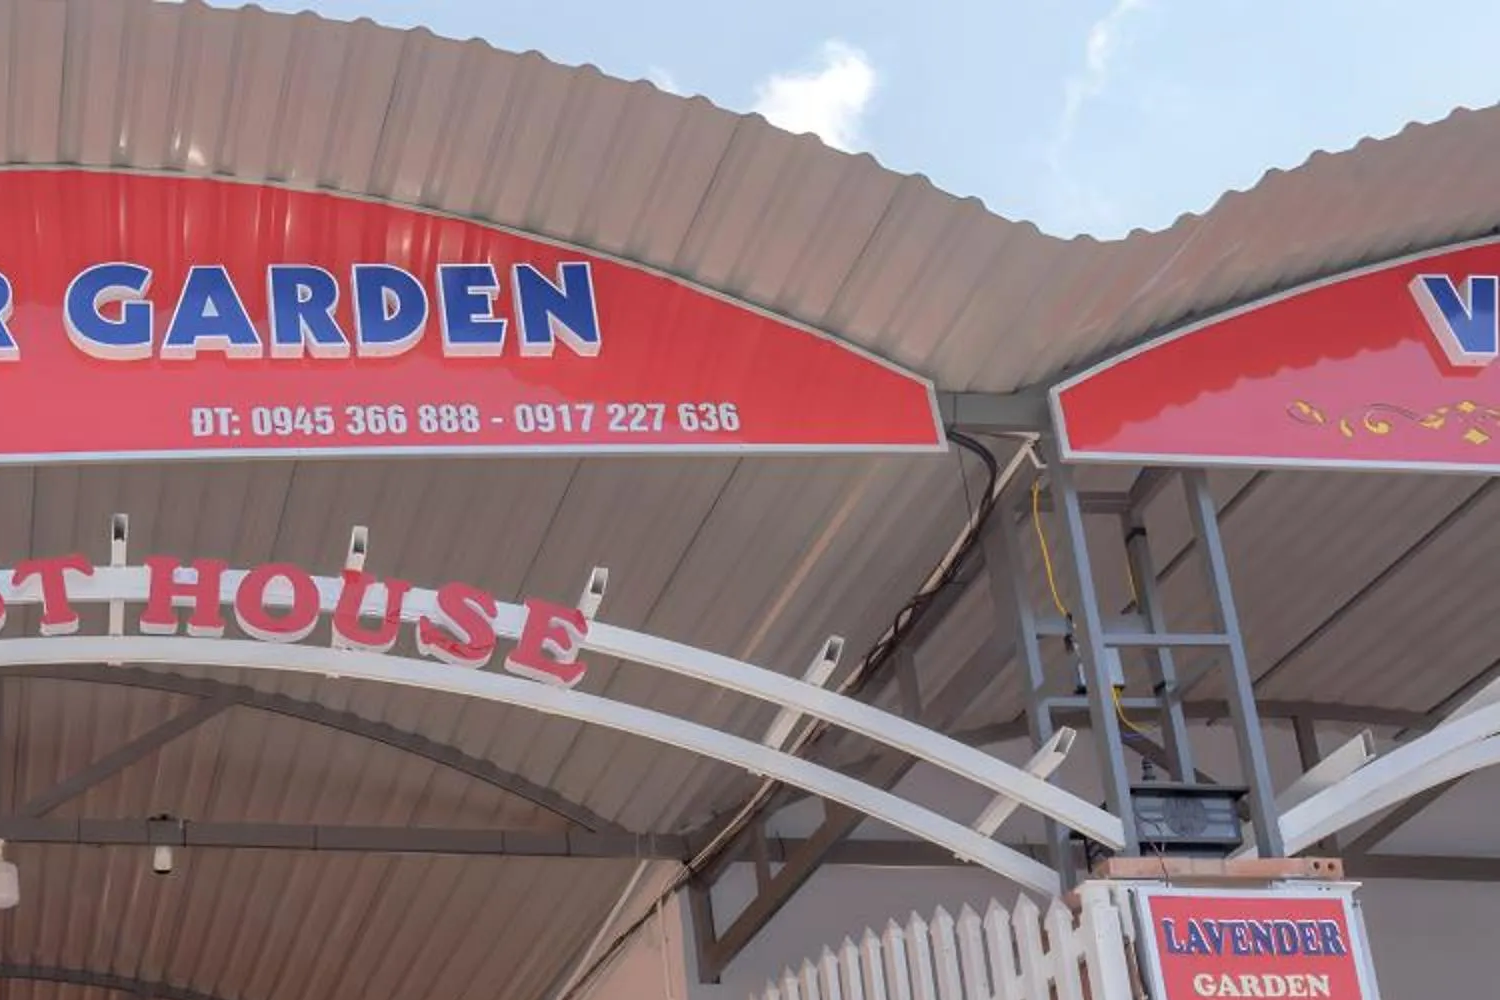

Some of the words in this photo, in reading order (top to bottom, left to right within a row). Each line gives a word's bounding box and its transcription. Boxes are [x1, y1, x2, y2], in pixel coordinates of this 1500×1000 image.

[62, 261, 601, 361] GARDEN
[191, 406, 240, 436] ĐT:
[251, 406, 335, 435] 0945
[346, 405, 407, 434] 366
[419, 404, 481, 433] 888
[515, 403, 594, 433] 0917
[606, 402, 665, 432] 227
[677, 402, 741, 432] 636
[137, 553, 592, 690] HOUSE
[1161, 917, 1347, 956] LAVENDER
[1193, 973, 1331, 998] GARDEN
